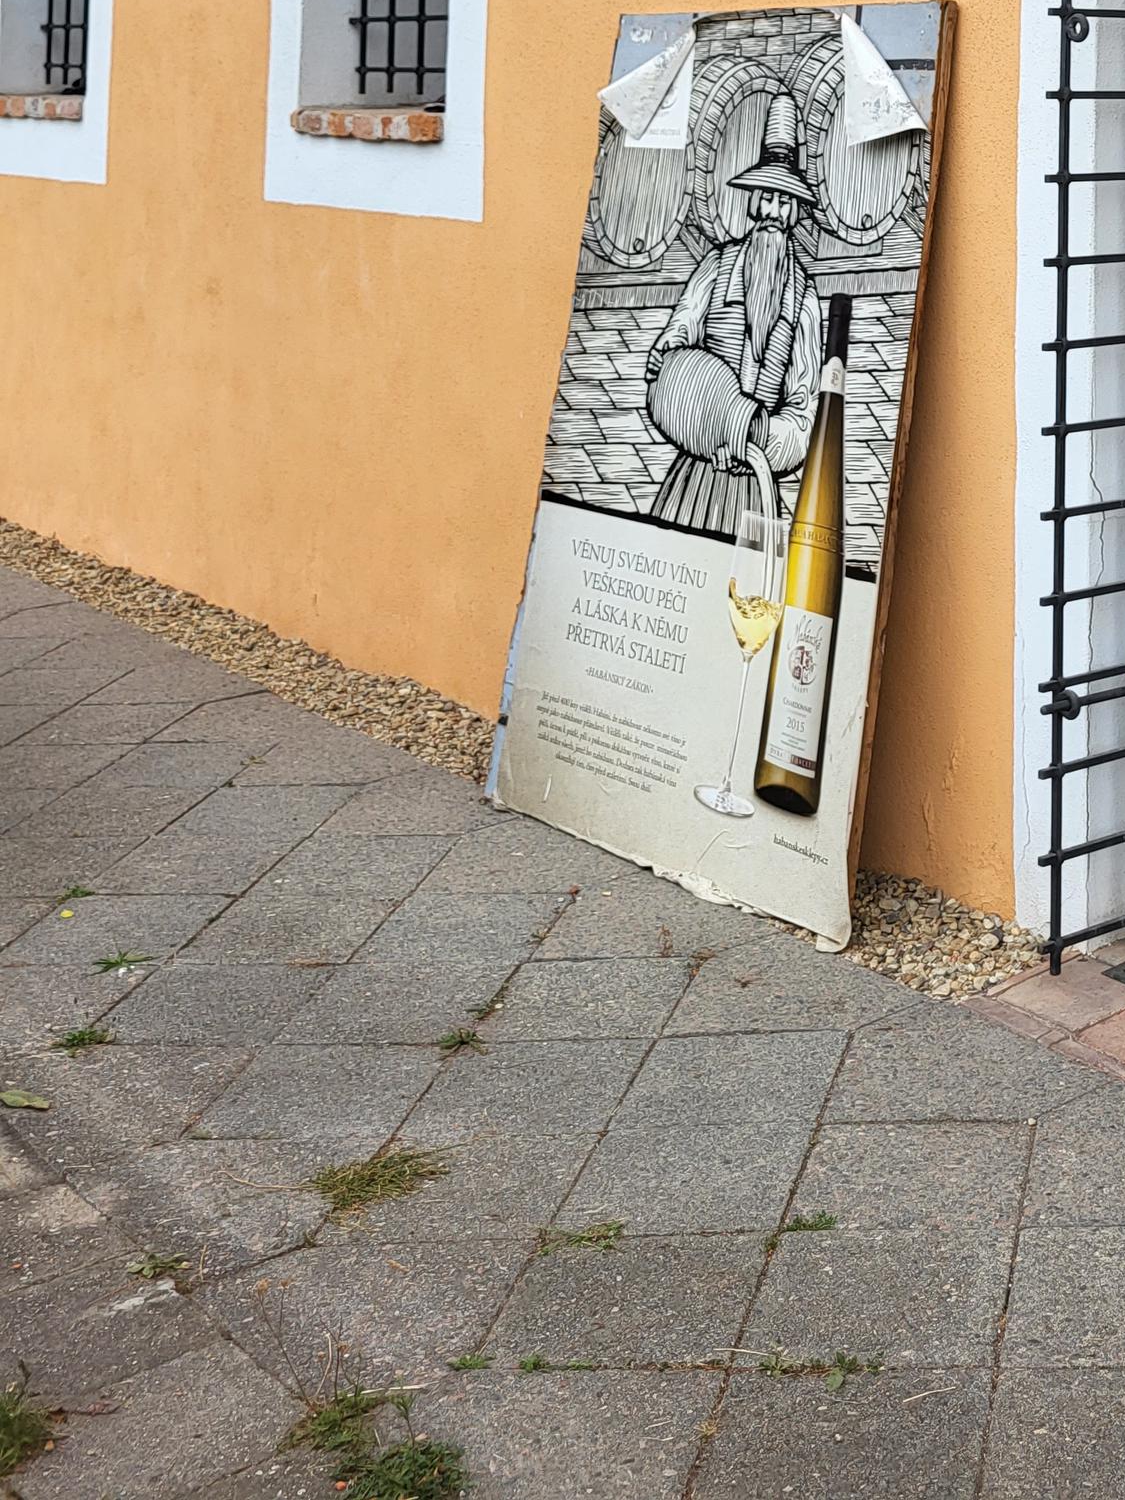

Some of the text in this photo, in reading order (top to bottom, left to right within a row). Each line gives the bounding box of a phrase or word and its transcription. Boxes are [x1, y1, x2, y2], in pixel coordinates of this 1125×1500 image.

[572, 539, 708, 589] VĚNUJ SVÉMU VÍNU
[583, 570, 688, 614] VEŠKEROU PÉČI
[571, 597, 689, 644] A LÁSKA K NĚMU
[565, 622, 688, 674] PŘETRVÁ STALETÍ
[785, 716, 805, 733] 2015
